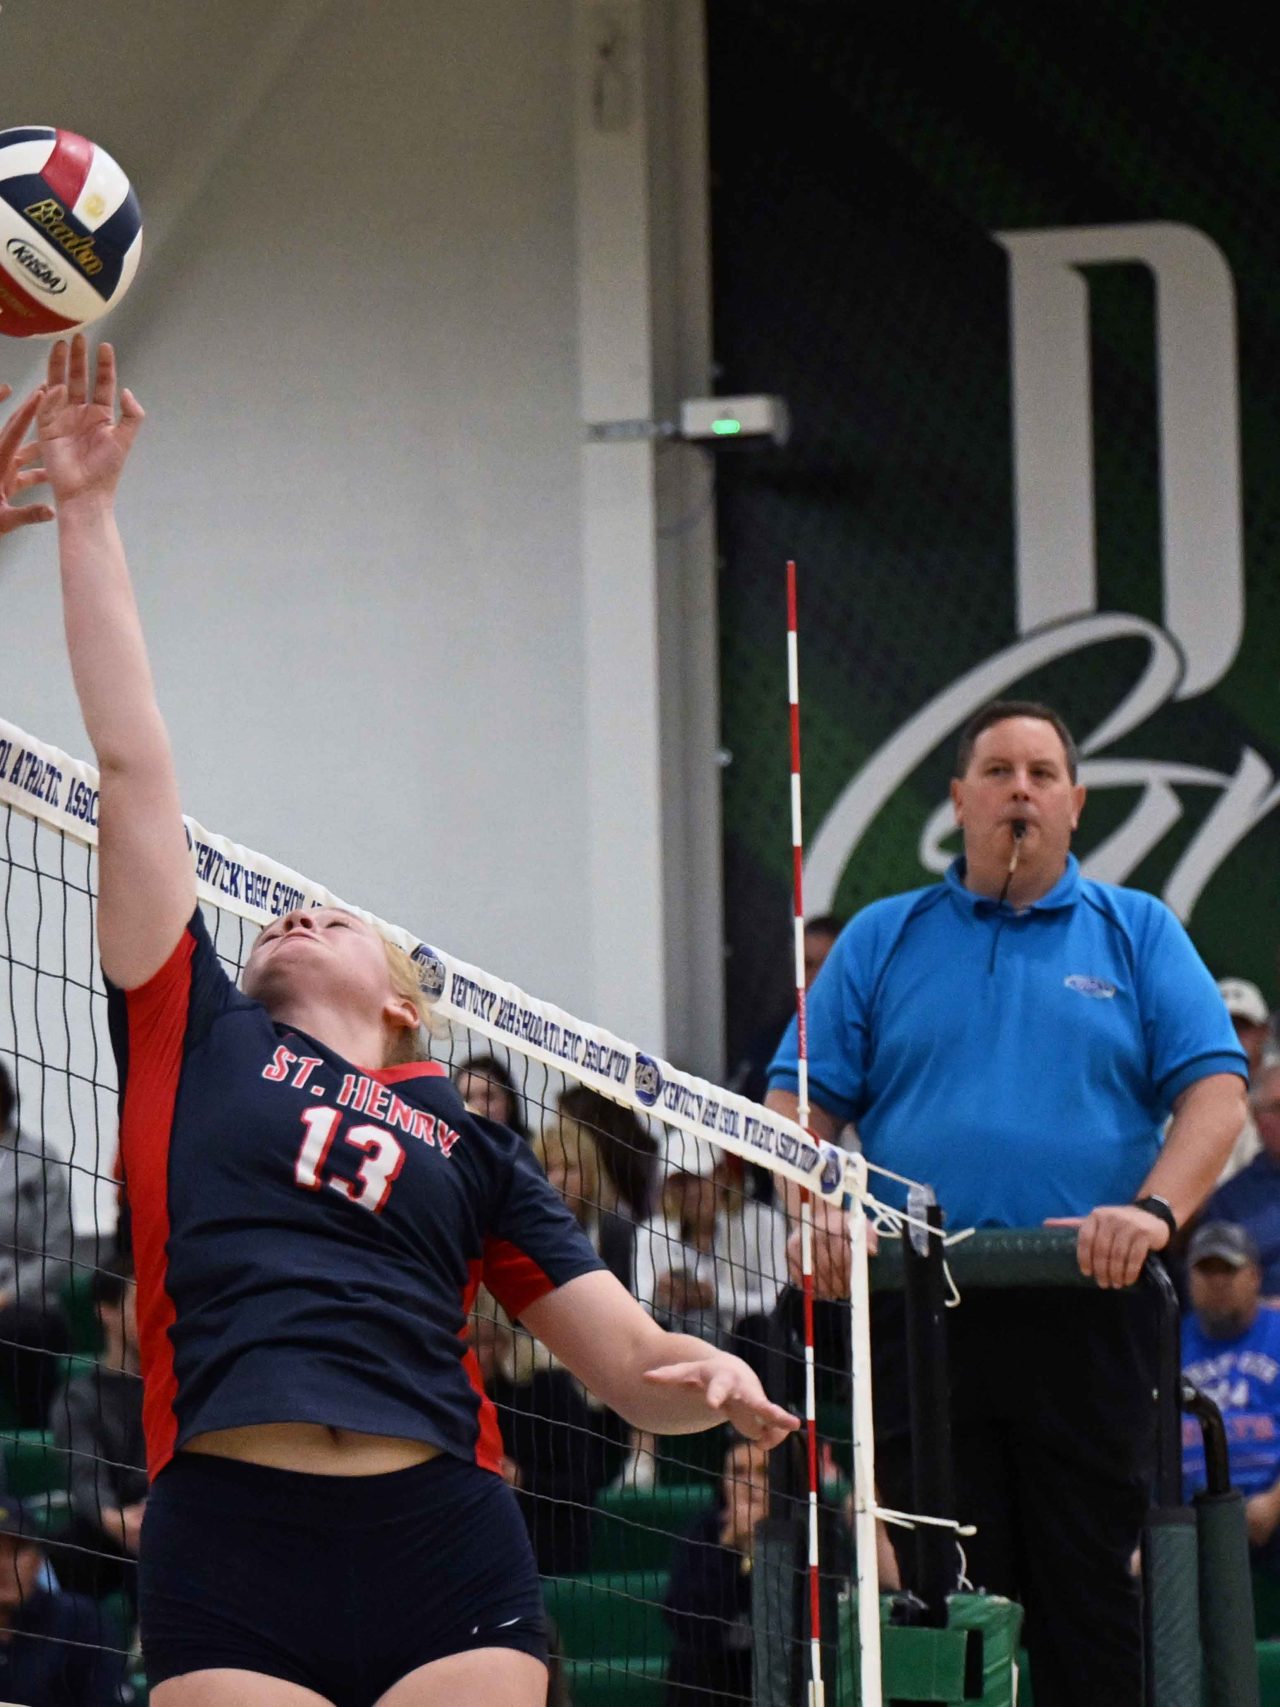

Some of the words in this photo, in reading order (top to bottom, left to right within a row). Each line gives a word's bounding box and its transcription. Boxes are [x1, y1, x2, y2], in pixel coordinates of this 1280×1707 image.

[13, 245, 62, 290] KHSAA
[23, 198, 104, 277] Baden
[261, 1044, 326, 1097] ST.
[336, 1073, 461, 1159] HENRY
[293, 1104, 407, 1216] 13
